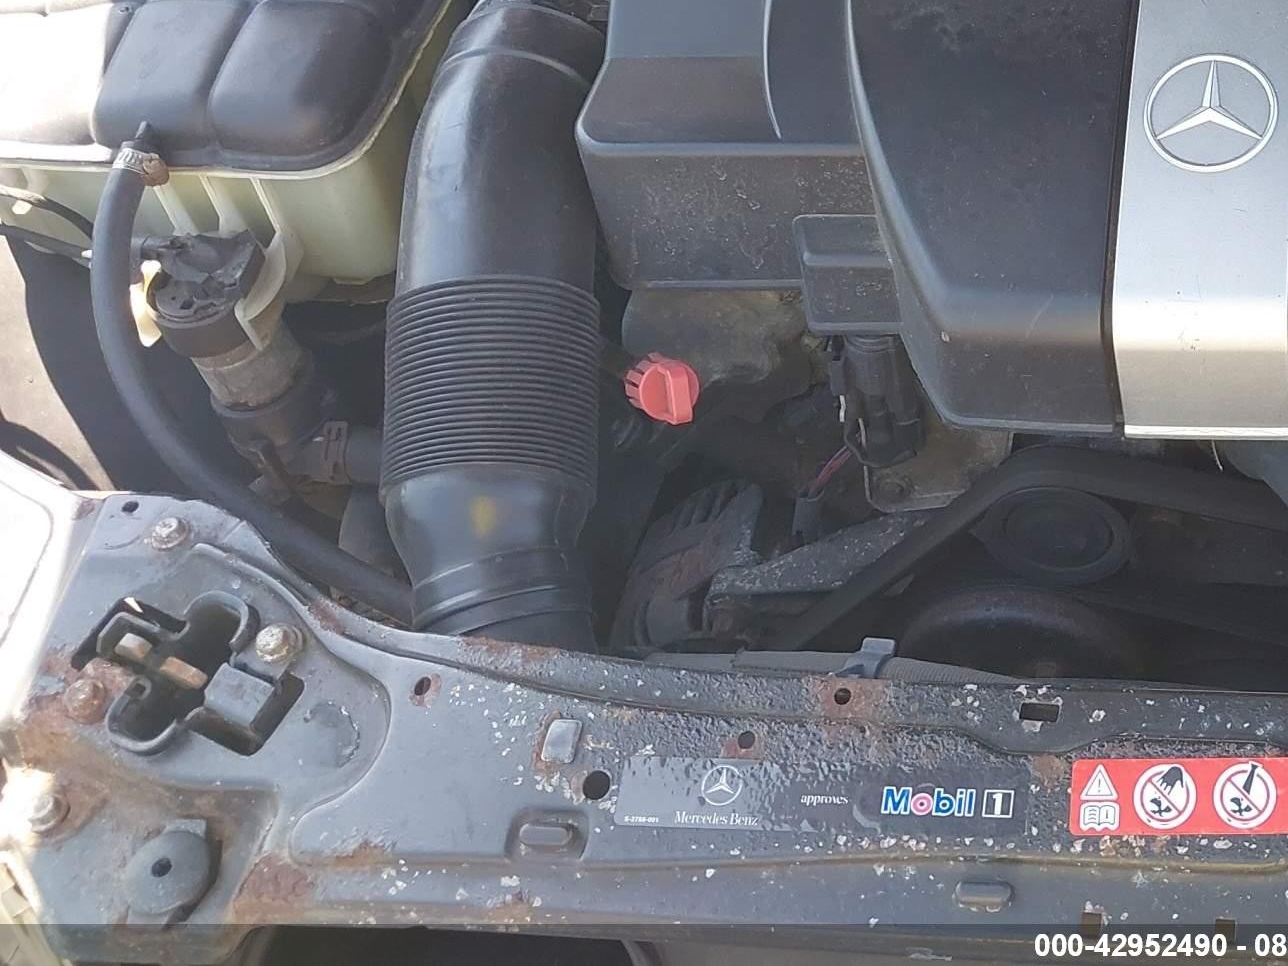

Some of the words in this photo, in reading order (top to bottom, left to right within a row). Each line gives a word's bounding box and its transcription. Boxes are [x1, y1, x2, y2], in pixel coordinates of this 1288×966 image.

[800, 793, 849, 807] approves
[880, 786, 976, 818] Mobil
[674, 811, 729, 826] Mercedes
[730, 812, 759, 827] Benz
